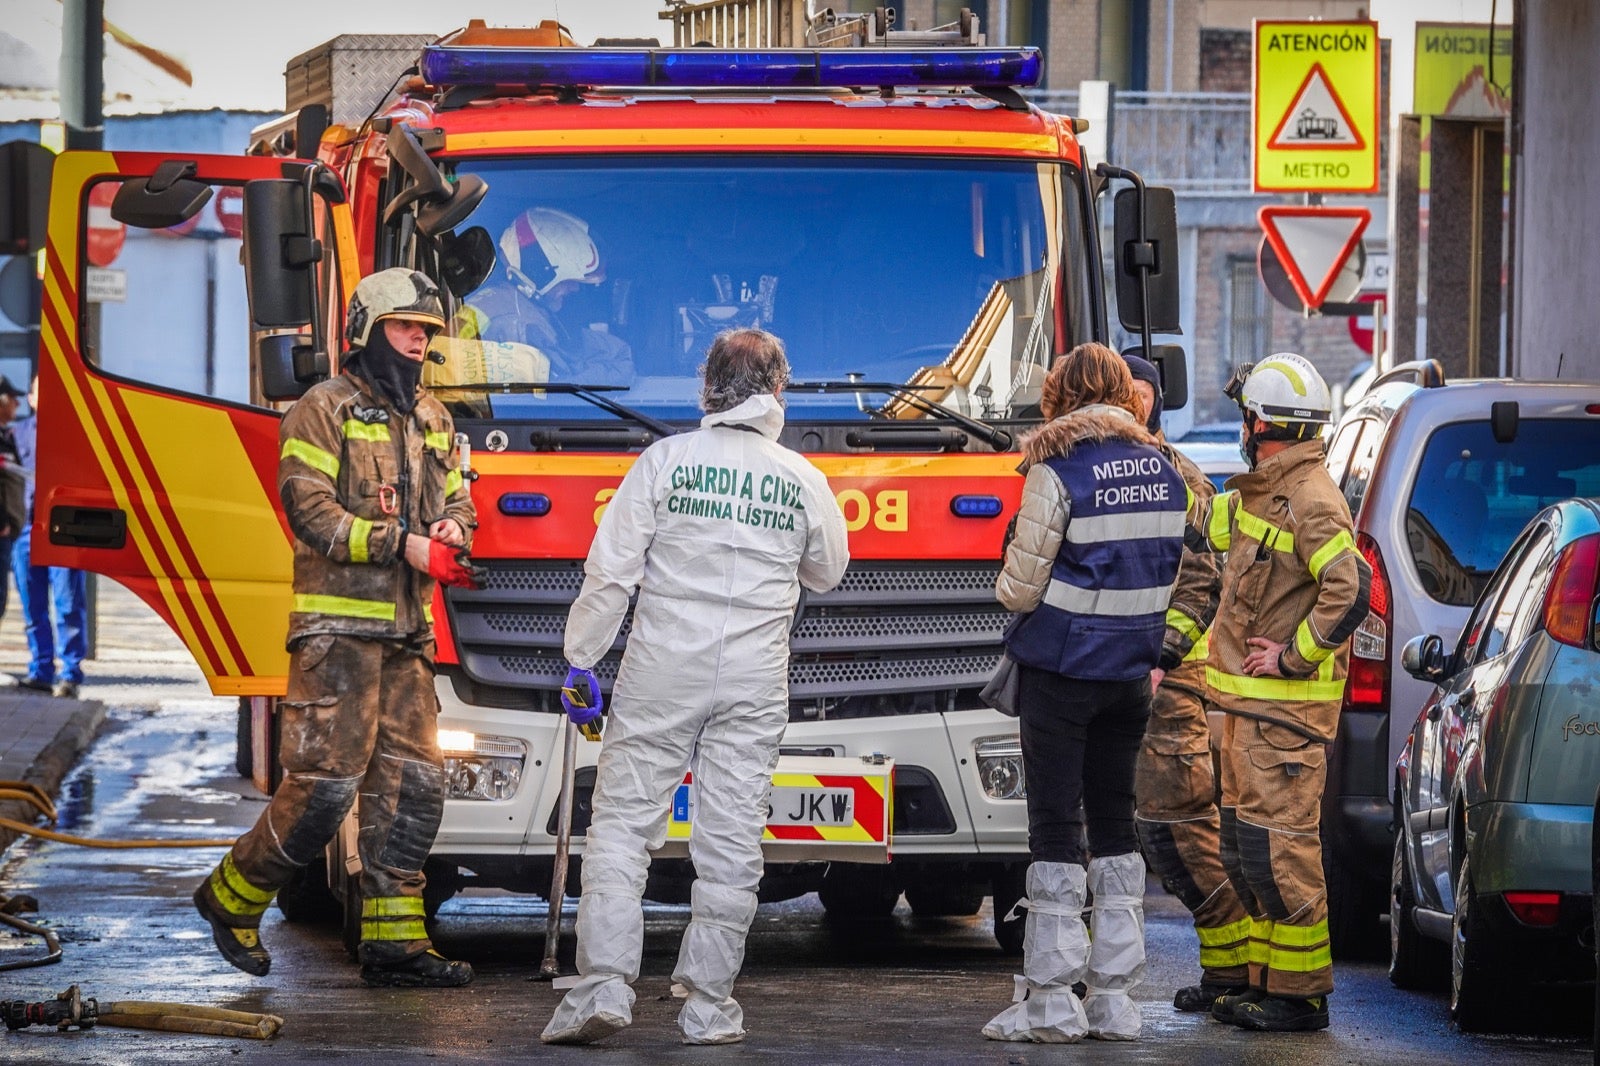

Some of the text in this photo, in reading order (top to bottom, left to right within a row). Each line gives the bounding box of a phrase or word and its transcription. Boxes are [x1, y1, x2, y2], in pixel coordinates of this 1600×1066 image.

[1268, 29, 1367, 51] ATENCIÓN
[1284, 163, 1350, 178] METRO
[1092, 457, 1162, 480] MEDICO
[1095, 483, 1169, 508] FORENSE
[788, 793, 848, 822] JKW
